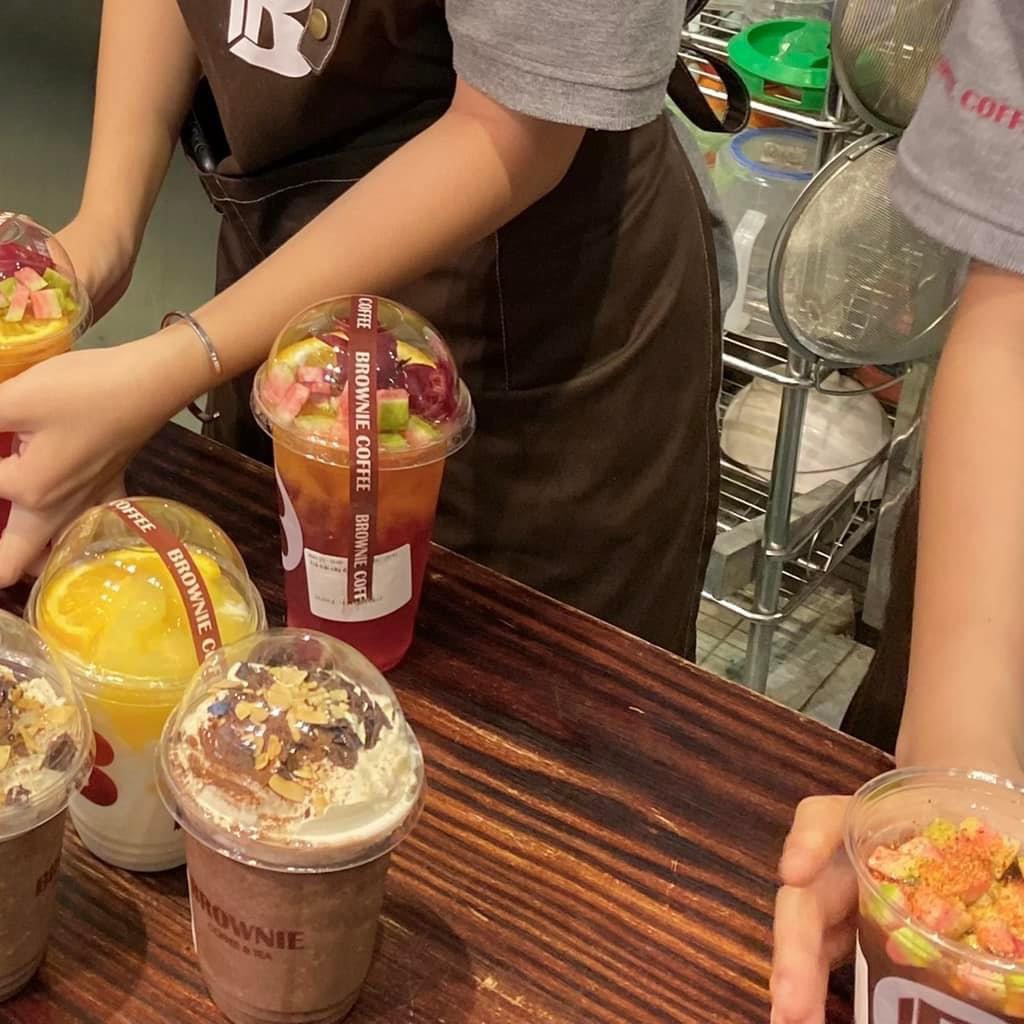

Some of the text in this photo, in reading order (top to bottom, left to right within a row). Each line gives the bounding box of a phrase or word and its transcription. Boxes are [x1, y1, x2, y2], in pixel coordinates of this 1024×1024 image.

[358, 297, 373, 329] COFFEE
[354, 351, 372, 492] BROWNIE COFFEE
[354, 514, 370, 568] BROWNIE
[166, 548, 213, 635] BROWNIE
